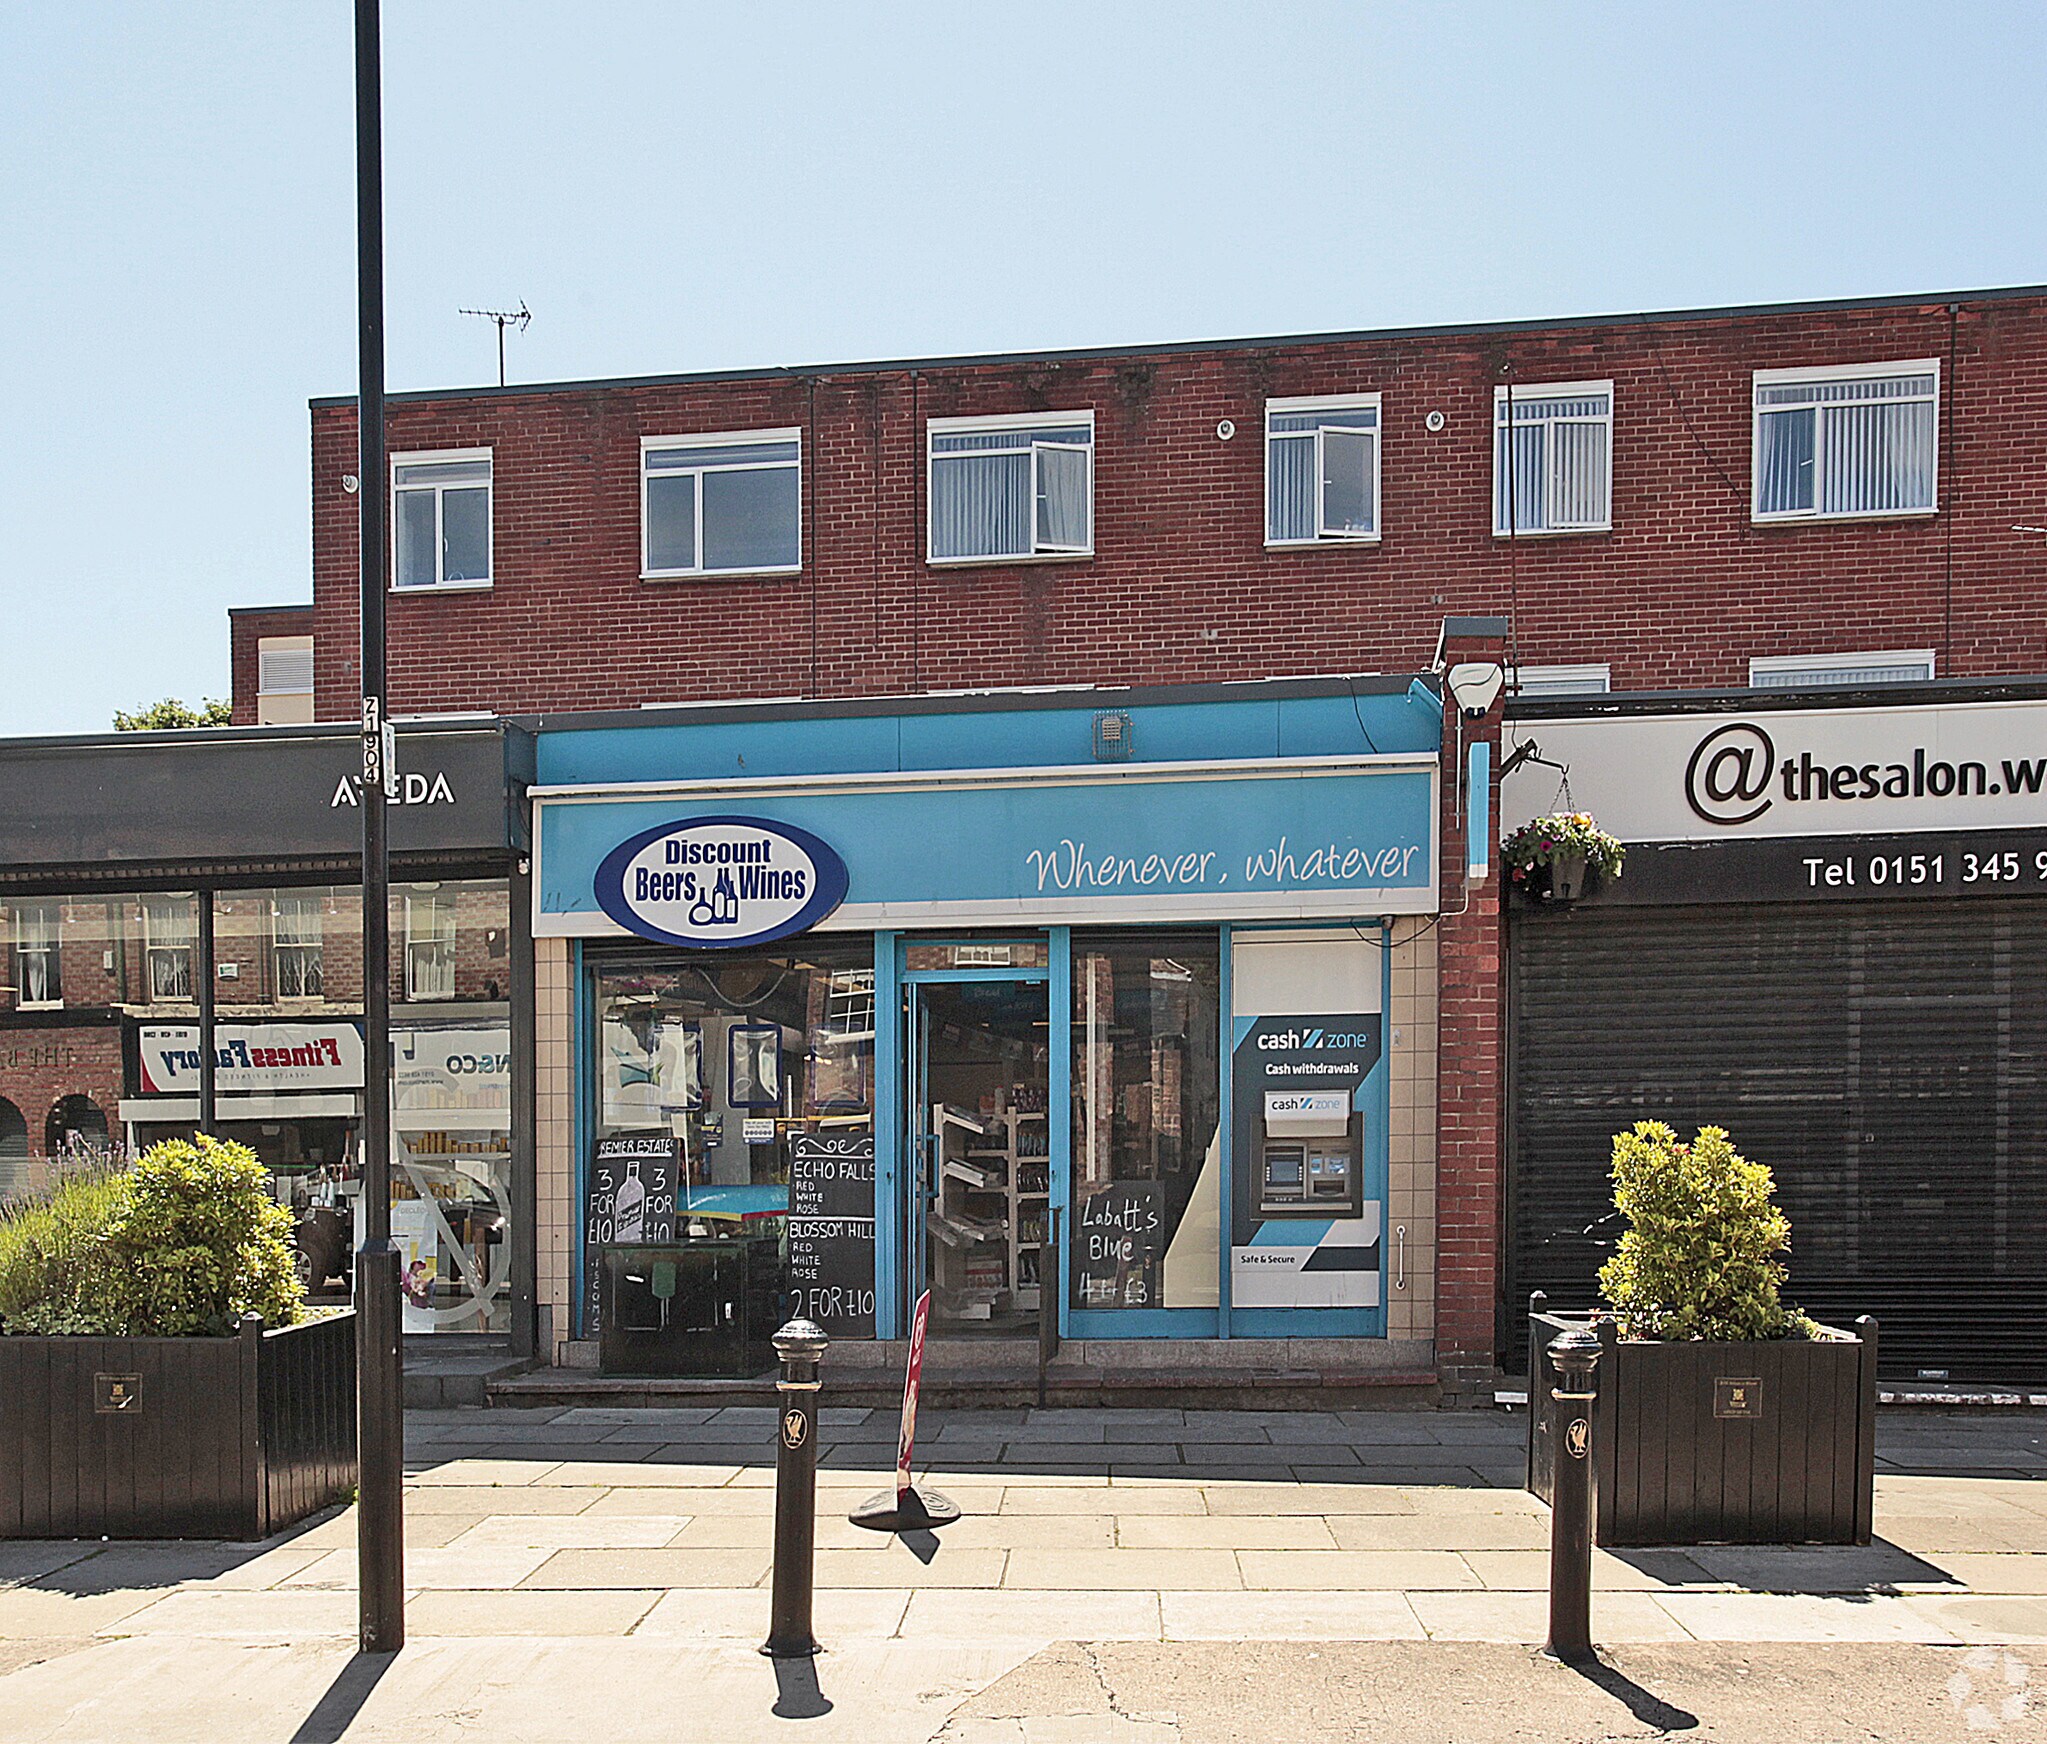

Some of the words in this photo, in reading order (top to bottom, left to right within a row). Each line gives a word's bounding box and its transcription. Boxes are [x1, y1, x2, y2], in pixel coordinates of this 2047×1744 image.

[665, 839, 771, 865] Discount
[1245, 836, 1419, 882] whatever
[1803, 857, 1855, 887] Tel
[1869, 854, 1943, 885] 0151
[1963, 853, 2020, 882] 345
[635, 867, 697, 902] Beers
[738, 865, 806, 900] Wines
[1258, 1029, 1299, 1050] cash
[1327, 1033, 1366, 1049] zone
[1265, 1063, 1291, 1075] Cash
[1292, 1062, 1359, 1075] withdrawals
[1271, 1098, 1298, 1110] cash
[1315, 1100, 1340, 1110] zone
[597, 1169, 613, 1191] 3
[652, 1168, 666, 1191] 3
[793, 1161, 835, 1180] ECHO
[839, 1162, 875, 1181] FALLS
[796, 1181, 815, 1191] RED
[590, 1194, 615, 1215] FOR
[645, 1195, 673, 1214] FOR
[796, 1192, 823, 1202] WHITE
[796, 1203, 819, 1214] ROSE
[1082, 1195, 1158, 1232] Labatt's
[789, 1221, 843, 1239] BLOSSOM
[848, 1222, 875, 1239] HILL
[793, 1241, 813, 1253] RED
[1089, 1234, 1134, 1261] Blue
[791, 1254, 821, 1266] WHITE
[1241, 1255, 1259, 1264] Safe
[1260, 1255, 1267, 1264] &
[1268, 1255, 1295, 1264] Secure
[791, 1267, 817, 1279] ROSE
[1124, 1277, 1148, 1304] £3
[790, 1288, 805, 1319] 2
[809, 1286, 842, 1318] FOR
[846, 1288, 875, 1316] £10
